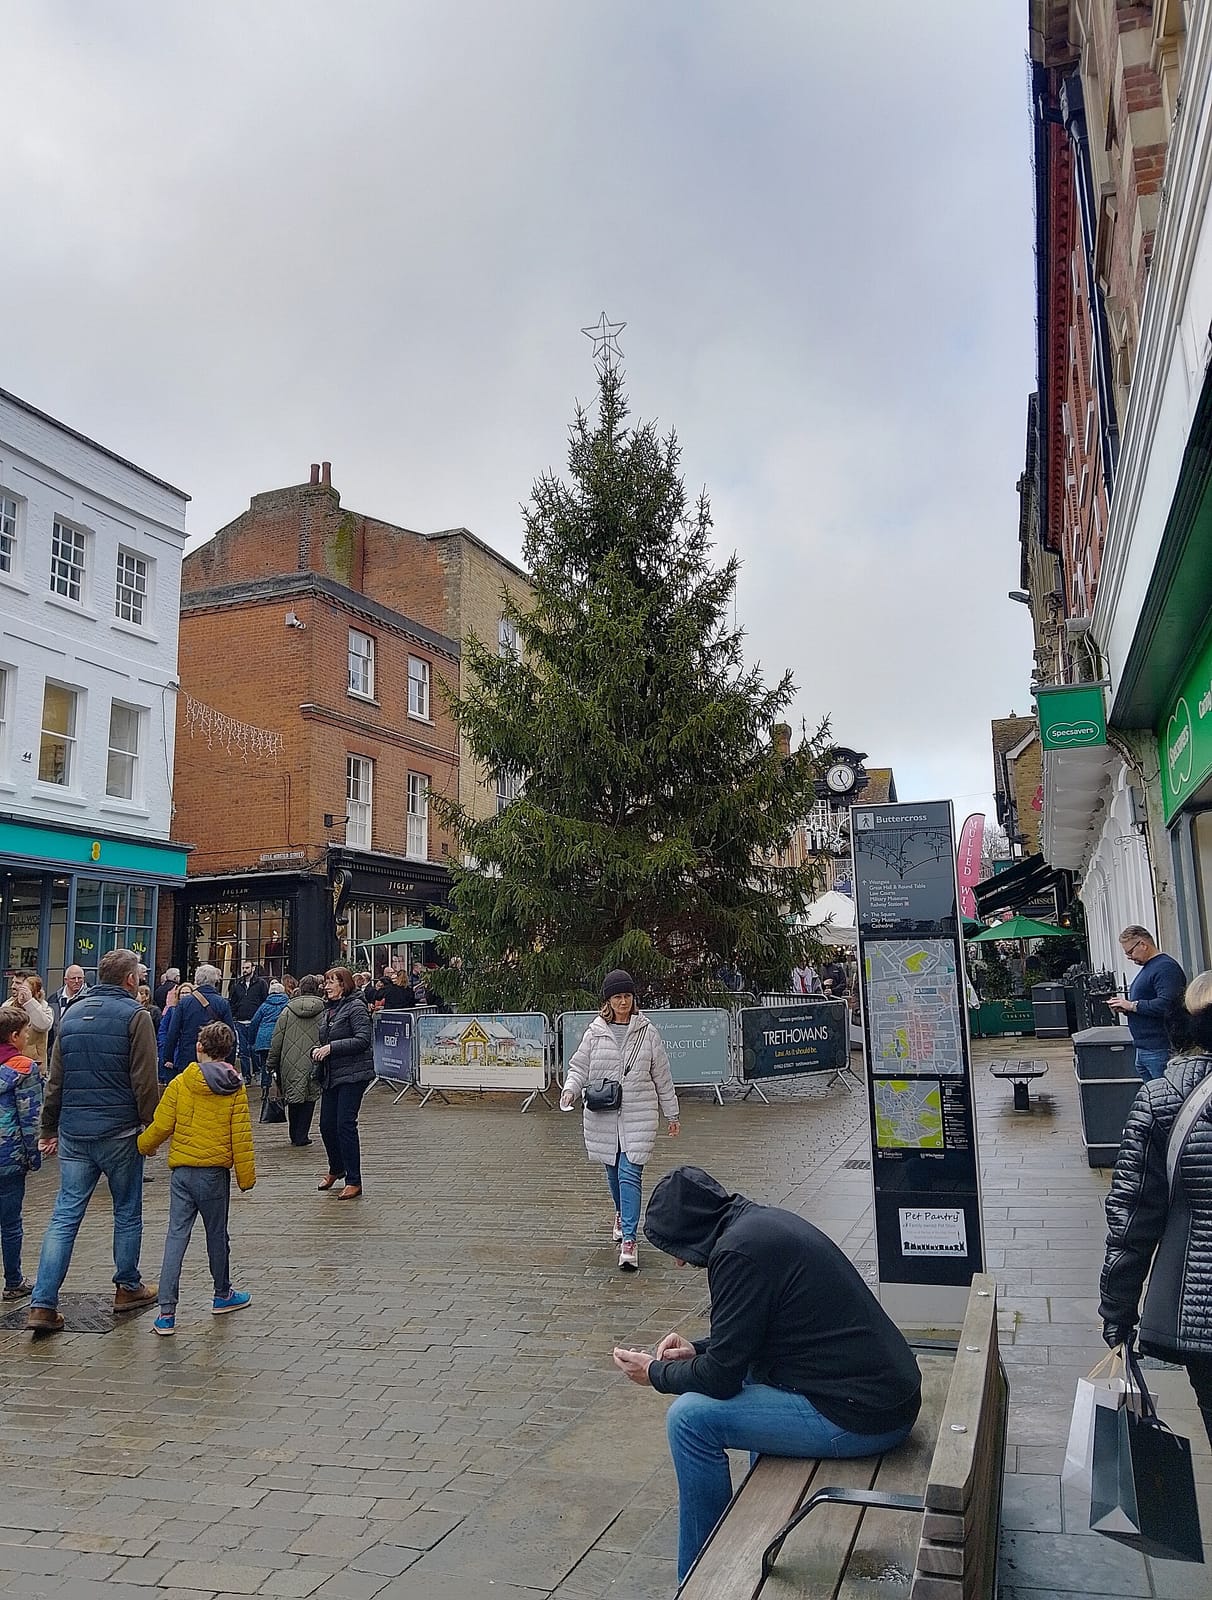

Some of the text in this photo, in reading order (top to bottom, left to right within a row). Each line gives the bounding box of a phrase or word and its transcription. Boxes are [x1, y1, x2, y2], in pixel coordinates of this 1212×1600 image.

[1052, 726, 1094, 737] Specsavers
[876, 813, 927, 824] Buttercross
[964, 820, 978, 875] MULLED
[389, 881, 415, 891] JIGSAW
[763, 1025, 829, 1046] TRETHOWANS
[796, 1047, 810, 1055] should
[905, 1212, 959, 1222] Pet Pantry
